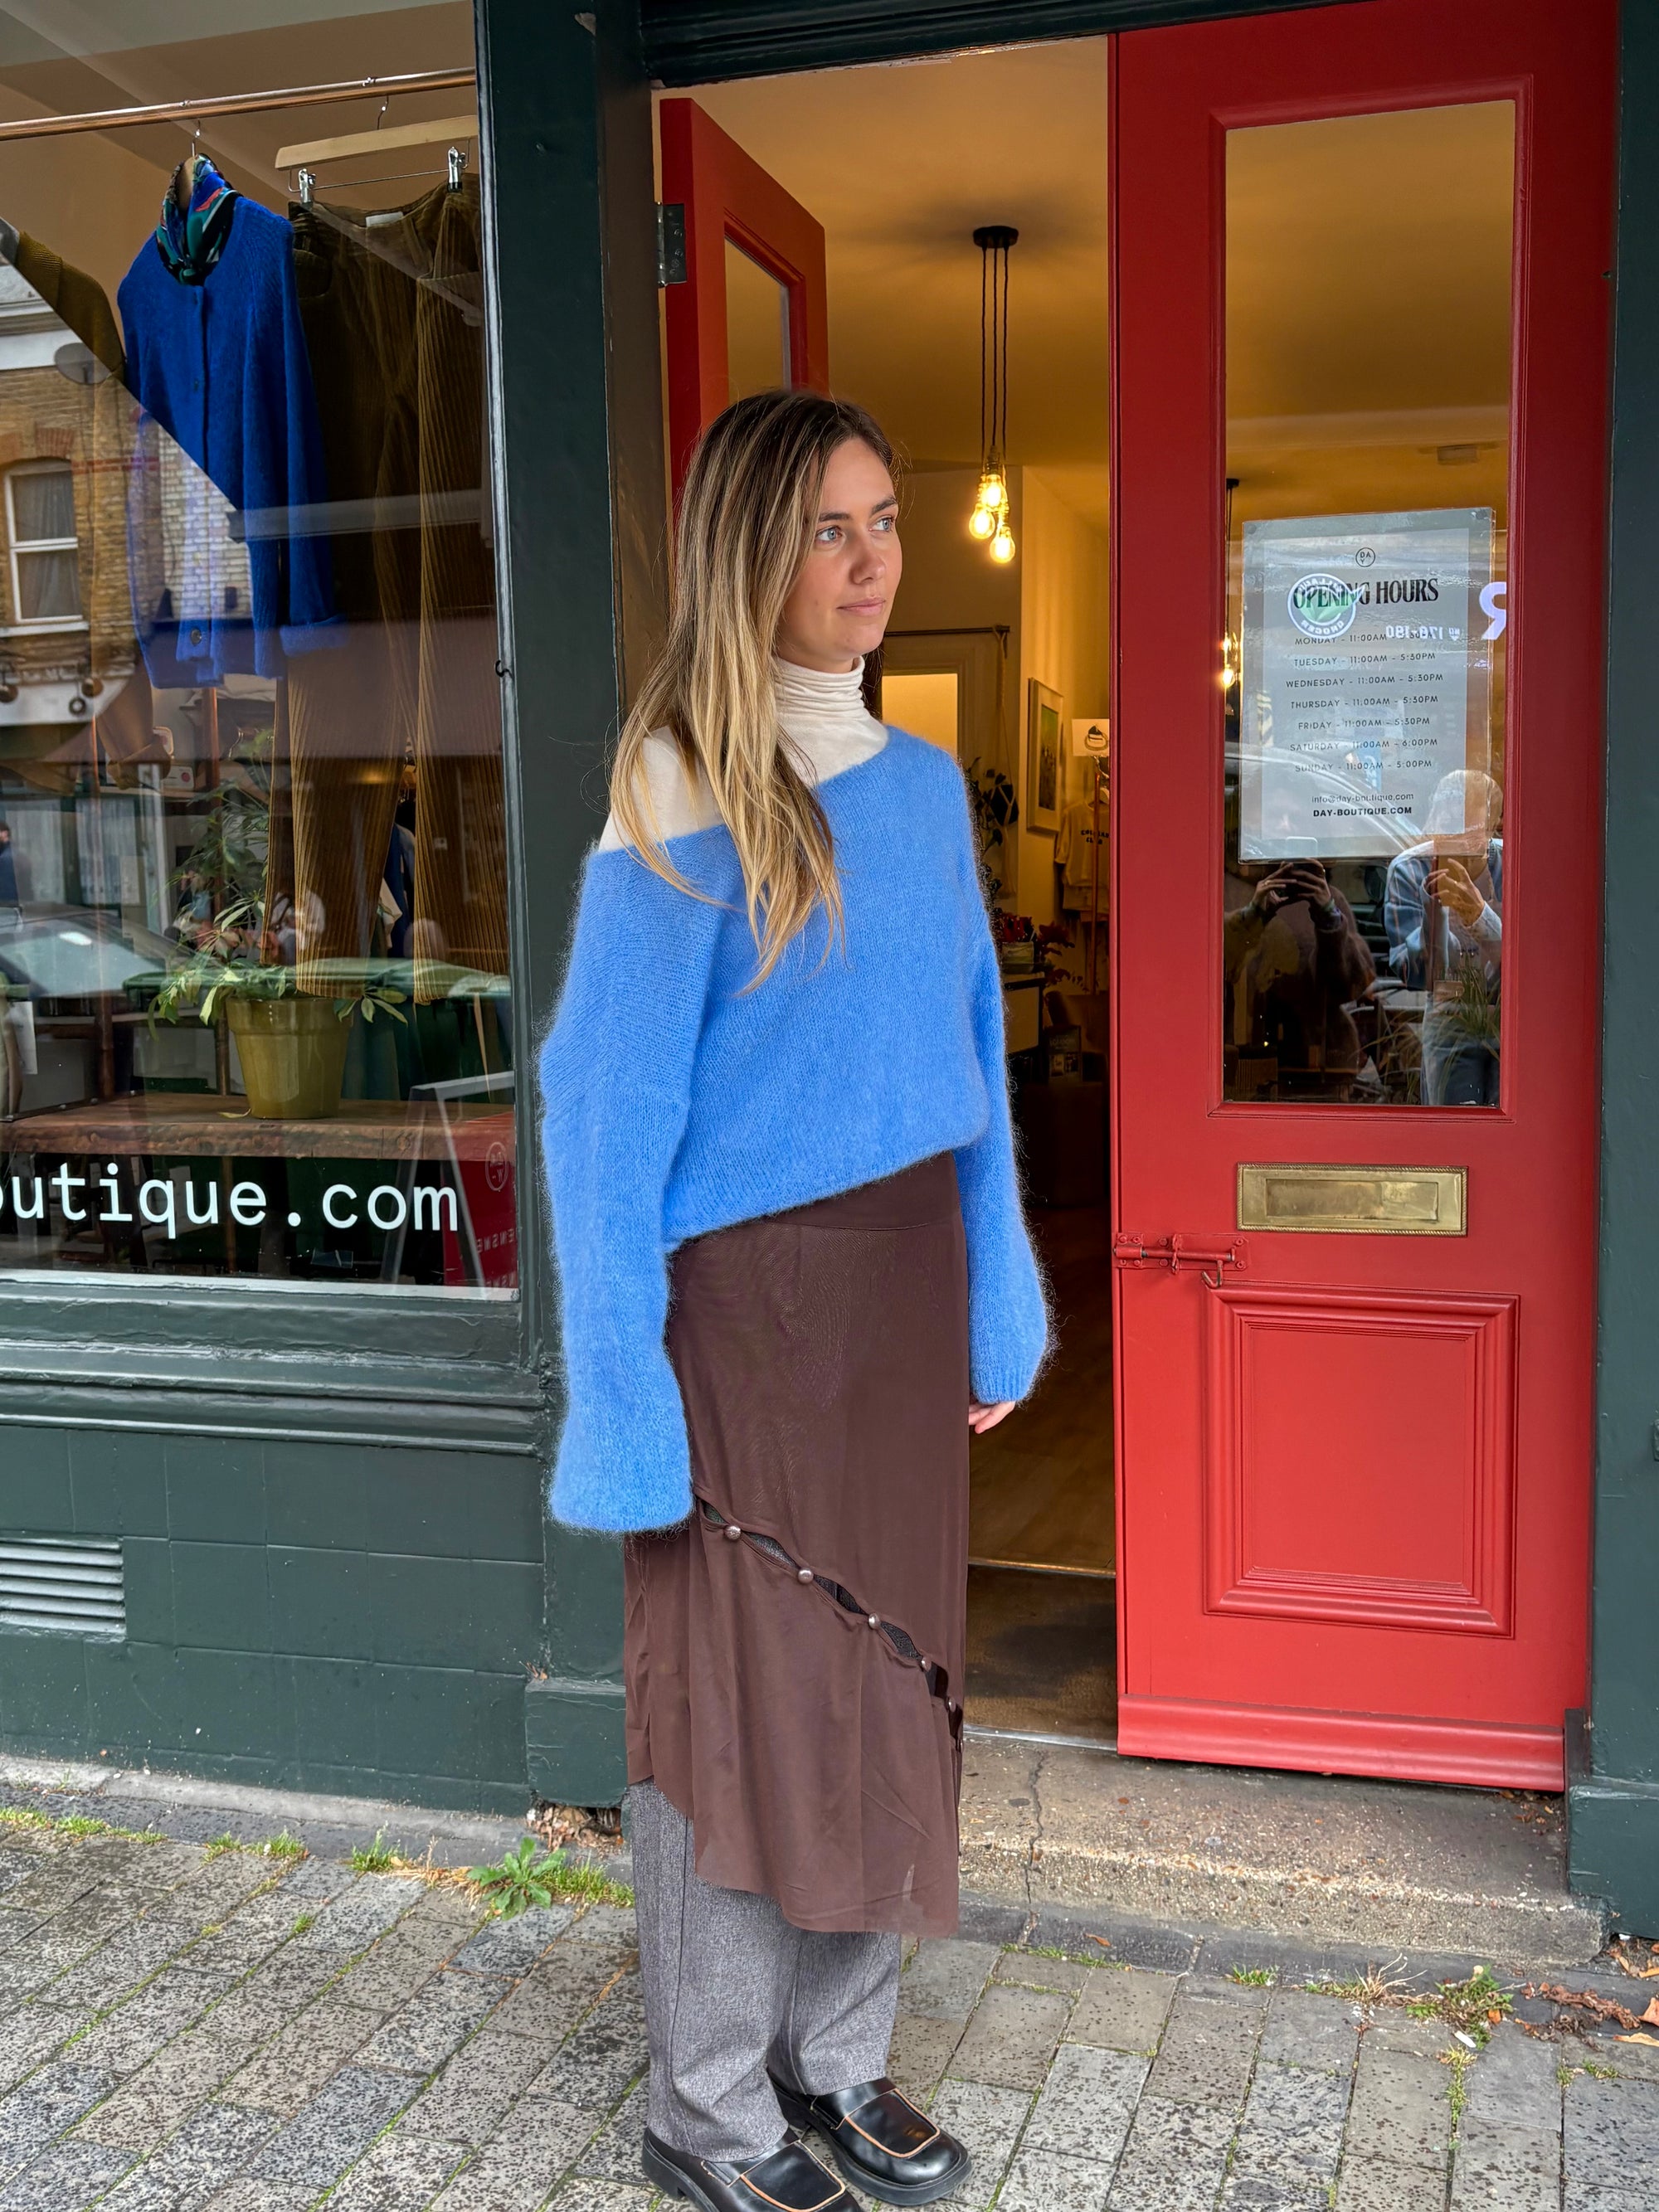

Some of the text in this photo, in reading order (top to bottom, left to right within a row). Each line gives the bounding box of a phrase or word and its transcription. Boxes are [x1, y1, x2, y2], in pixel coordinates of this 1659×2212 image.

[1293, 578, 1439, 609] OPENING HOURS
[1295, 637, 1337, 645] MONDAY
[1350, 634, 1387, 642] 11:00AM
[1294, 657, 1337, 667] TUESDAY
[1350, 655, 1387, 664] 11:00AM
[1400, 653, 1435, 661] 5:30PM
[1286, 678, 1345, 688] WEDNESDAY
[1358, 676, 1395, 684] 11:00AM
[1408, 673, 1443, 682] 5:30PM
[1291, 699, 1340, 708] THURSDAY
[1353, 698, 1390, 706] 11:00AM
[1403, 695, 1438, 704] 5:30PM
[1298, 722, 1331, 730] FRIDAY
[1345, 719, 1382, 727] 11:00AM
[1394, 717, 1430, 726] 5:30PM
[1290, 742, 1339, 751] SATURDAY
[1402, 738, 1438, 746] 6:00PM
[1295, 763, 1333, 772] SUNDAY
[1346, 761, 1384, 770] 11:00AM
[1396, 760, 1432, 768] 5:00PM
[1313, 806, 1413, 817] DAY-BOUTIQUE.COM
